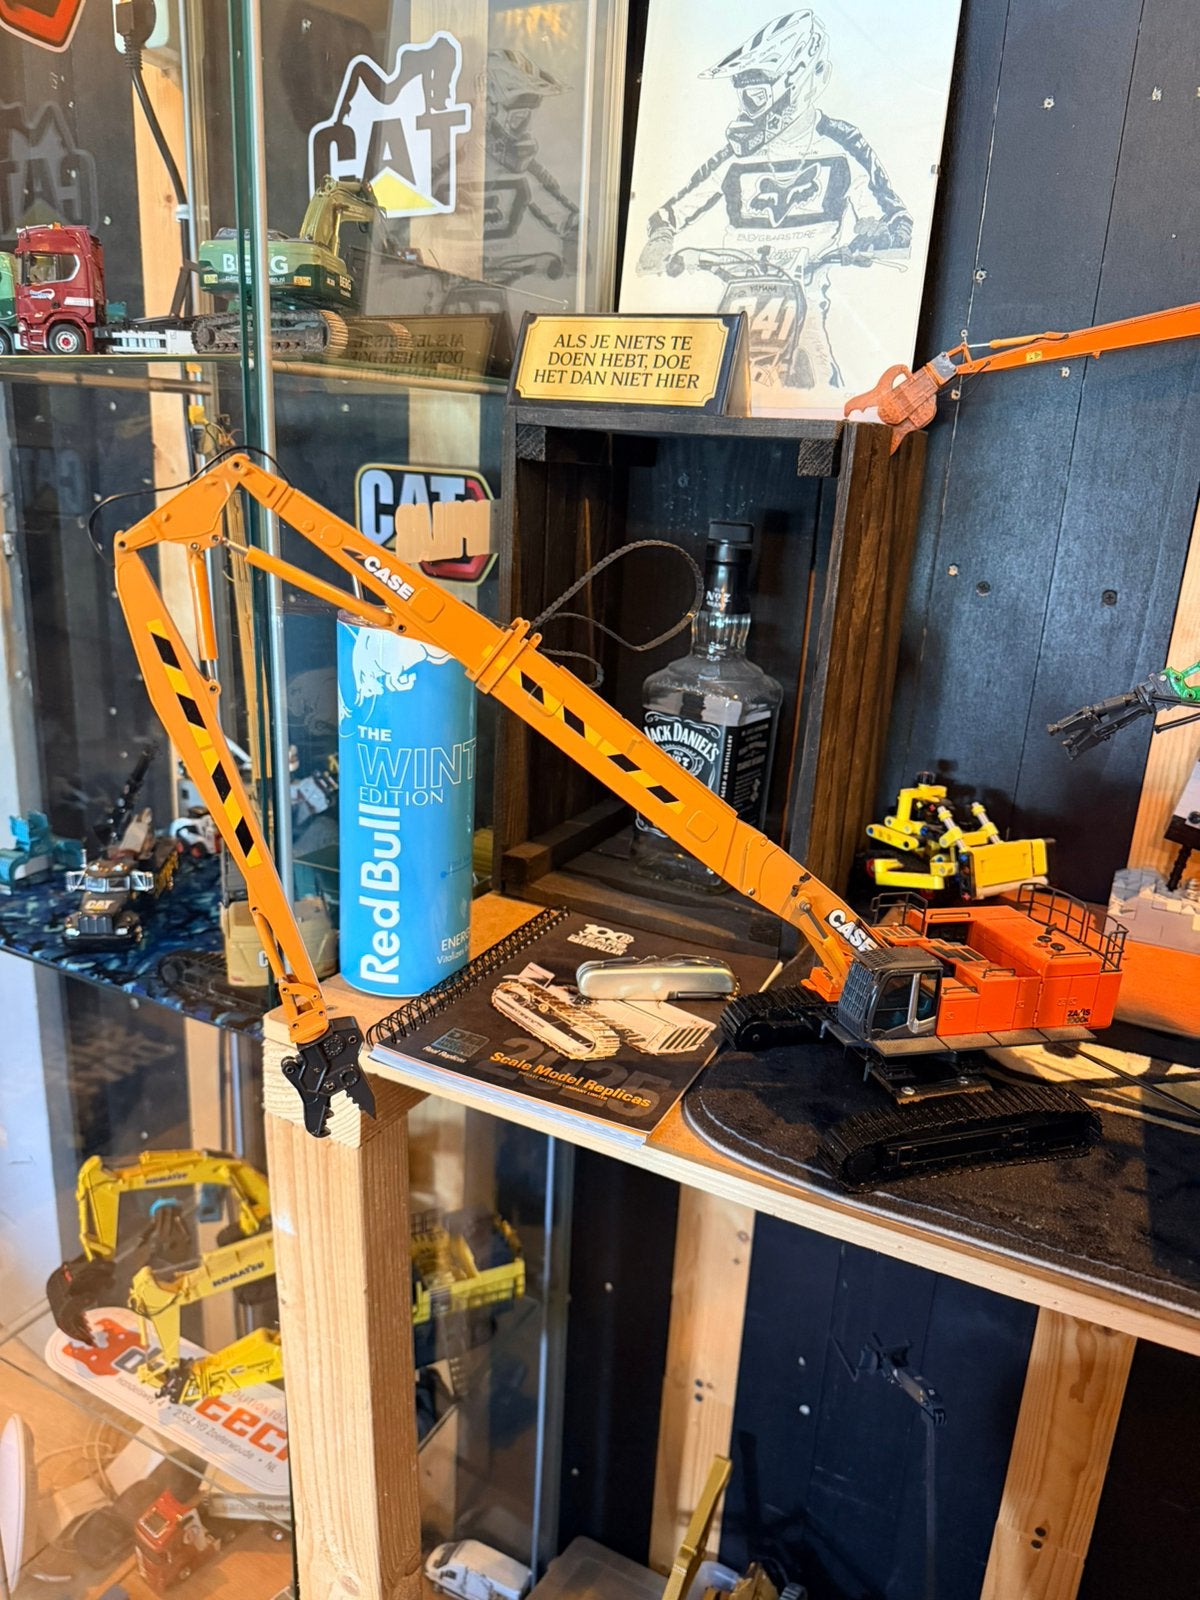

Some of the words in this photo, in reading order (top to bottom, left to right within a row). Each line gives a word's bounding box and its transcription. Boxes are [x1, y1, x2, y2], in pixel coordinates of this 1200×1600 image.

[313, 110, 466, 206] CAT
[222, 253, 289, 275] BEG
[553, 334, 587, 348] ALS
[590, 334, 611, 349] JE
[613, 335, 666, 350] NIETS
[670, 336, 693, 351] TE
[547, 352, 596, 367] DOEN
[600, 353, 648, 370] HEBT,
[652, 354, 692, 370] DOE
[533, 369, 568, 384] HET
[570, 370, 607, 386] DAN
[610, 371, 653, 387] NIET
[655, 373, 700, 389] HIER
[364, 555, 416, 600] CASE
[357, 725, 392, 742] THE
[643, 725, 672, 743] JACK
[673, 721, 720, 763] DANIEL'S
[357, 737, 477, 789] WINT
[359, 786, 443, 806] EDITION
[358, 802, 401, 892] Bull
[85, 900, 115, 910] CAT
[358, 896, 400, 984] Red
[584, 924, 635, 944] 100
[828, 909, 878, 952] CASE
[489, 1051, 531, 1072] Scale
[532, 1064, 585, 1086] Model
[583, 1079, 652, 1108] Replicas
[145, 1172, 188, 1185] KOMATSU
[212, 1262, 265, 1288] KOMATSU
